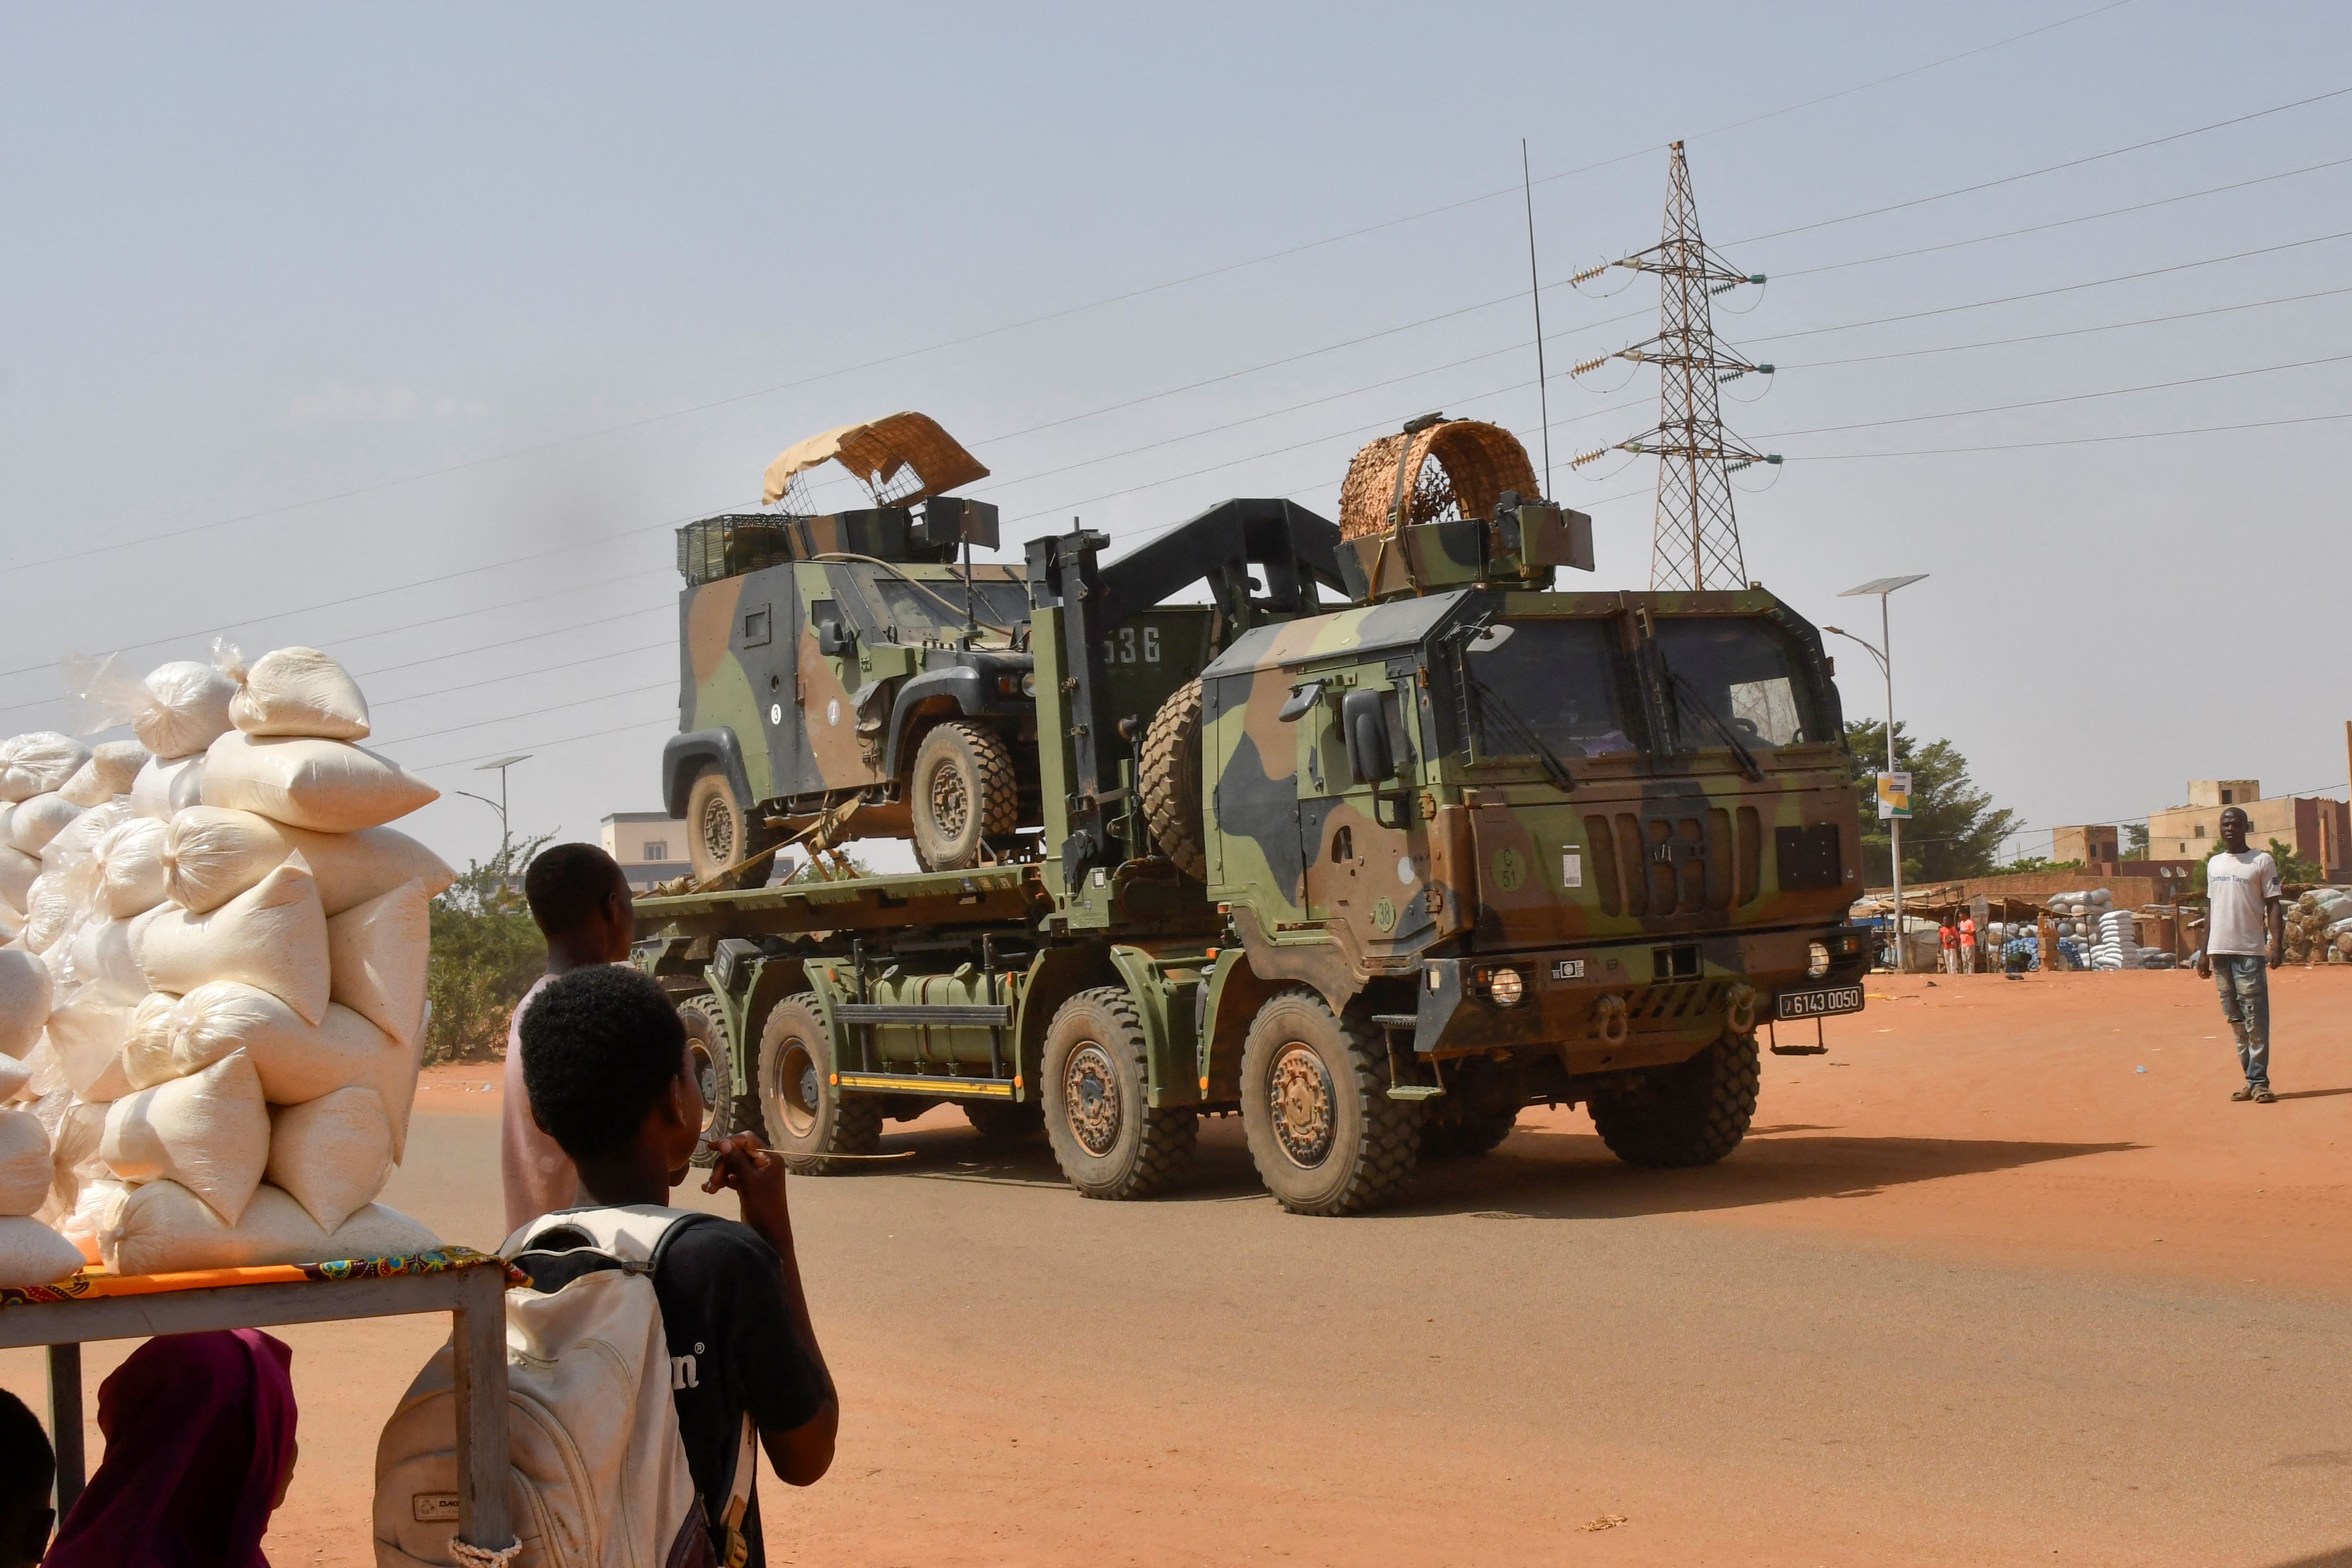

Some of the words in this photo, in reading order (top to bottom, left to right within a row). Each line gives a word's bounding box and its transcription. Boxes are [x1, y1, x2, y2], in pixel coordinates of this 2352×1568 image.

[1504, 849, 1512, 866] C
[1503, 870, 1516, 887] 51
[2232, 875, 2249, 884] Tare
[1379, 903, 1391, 924] 38
[1793, 994, 1825, 1014] 6143
[1828, 990, 1859, 1010] 0050
